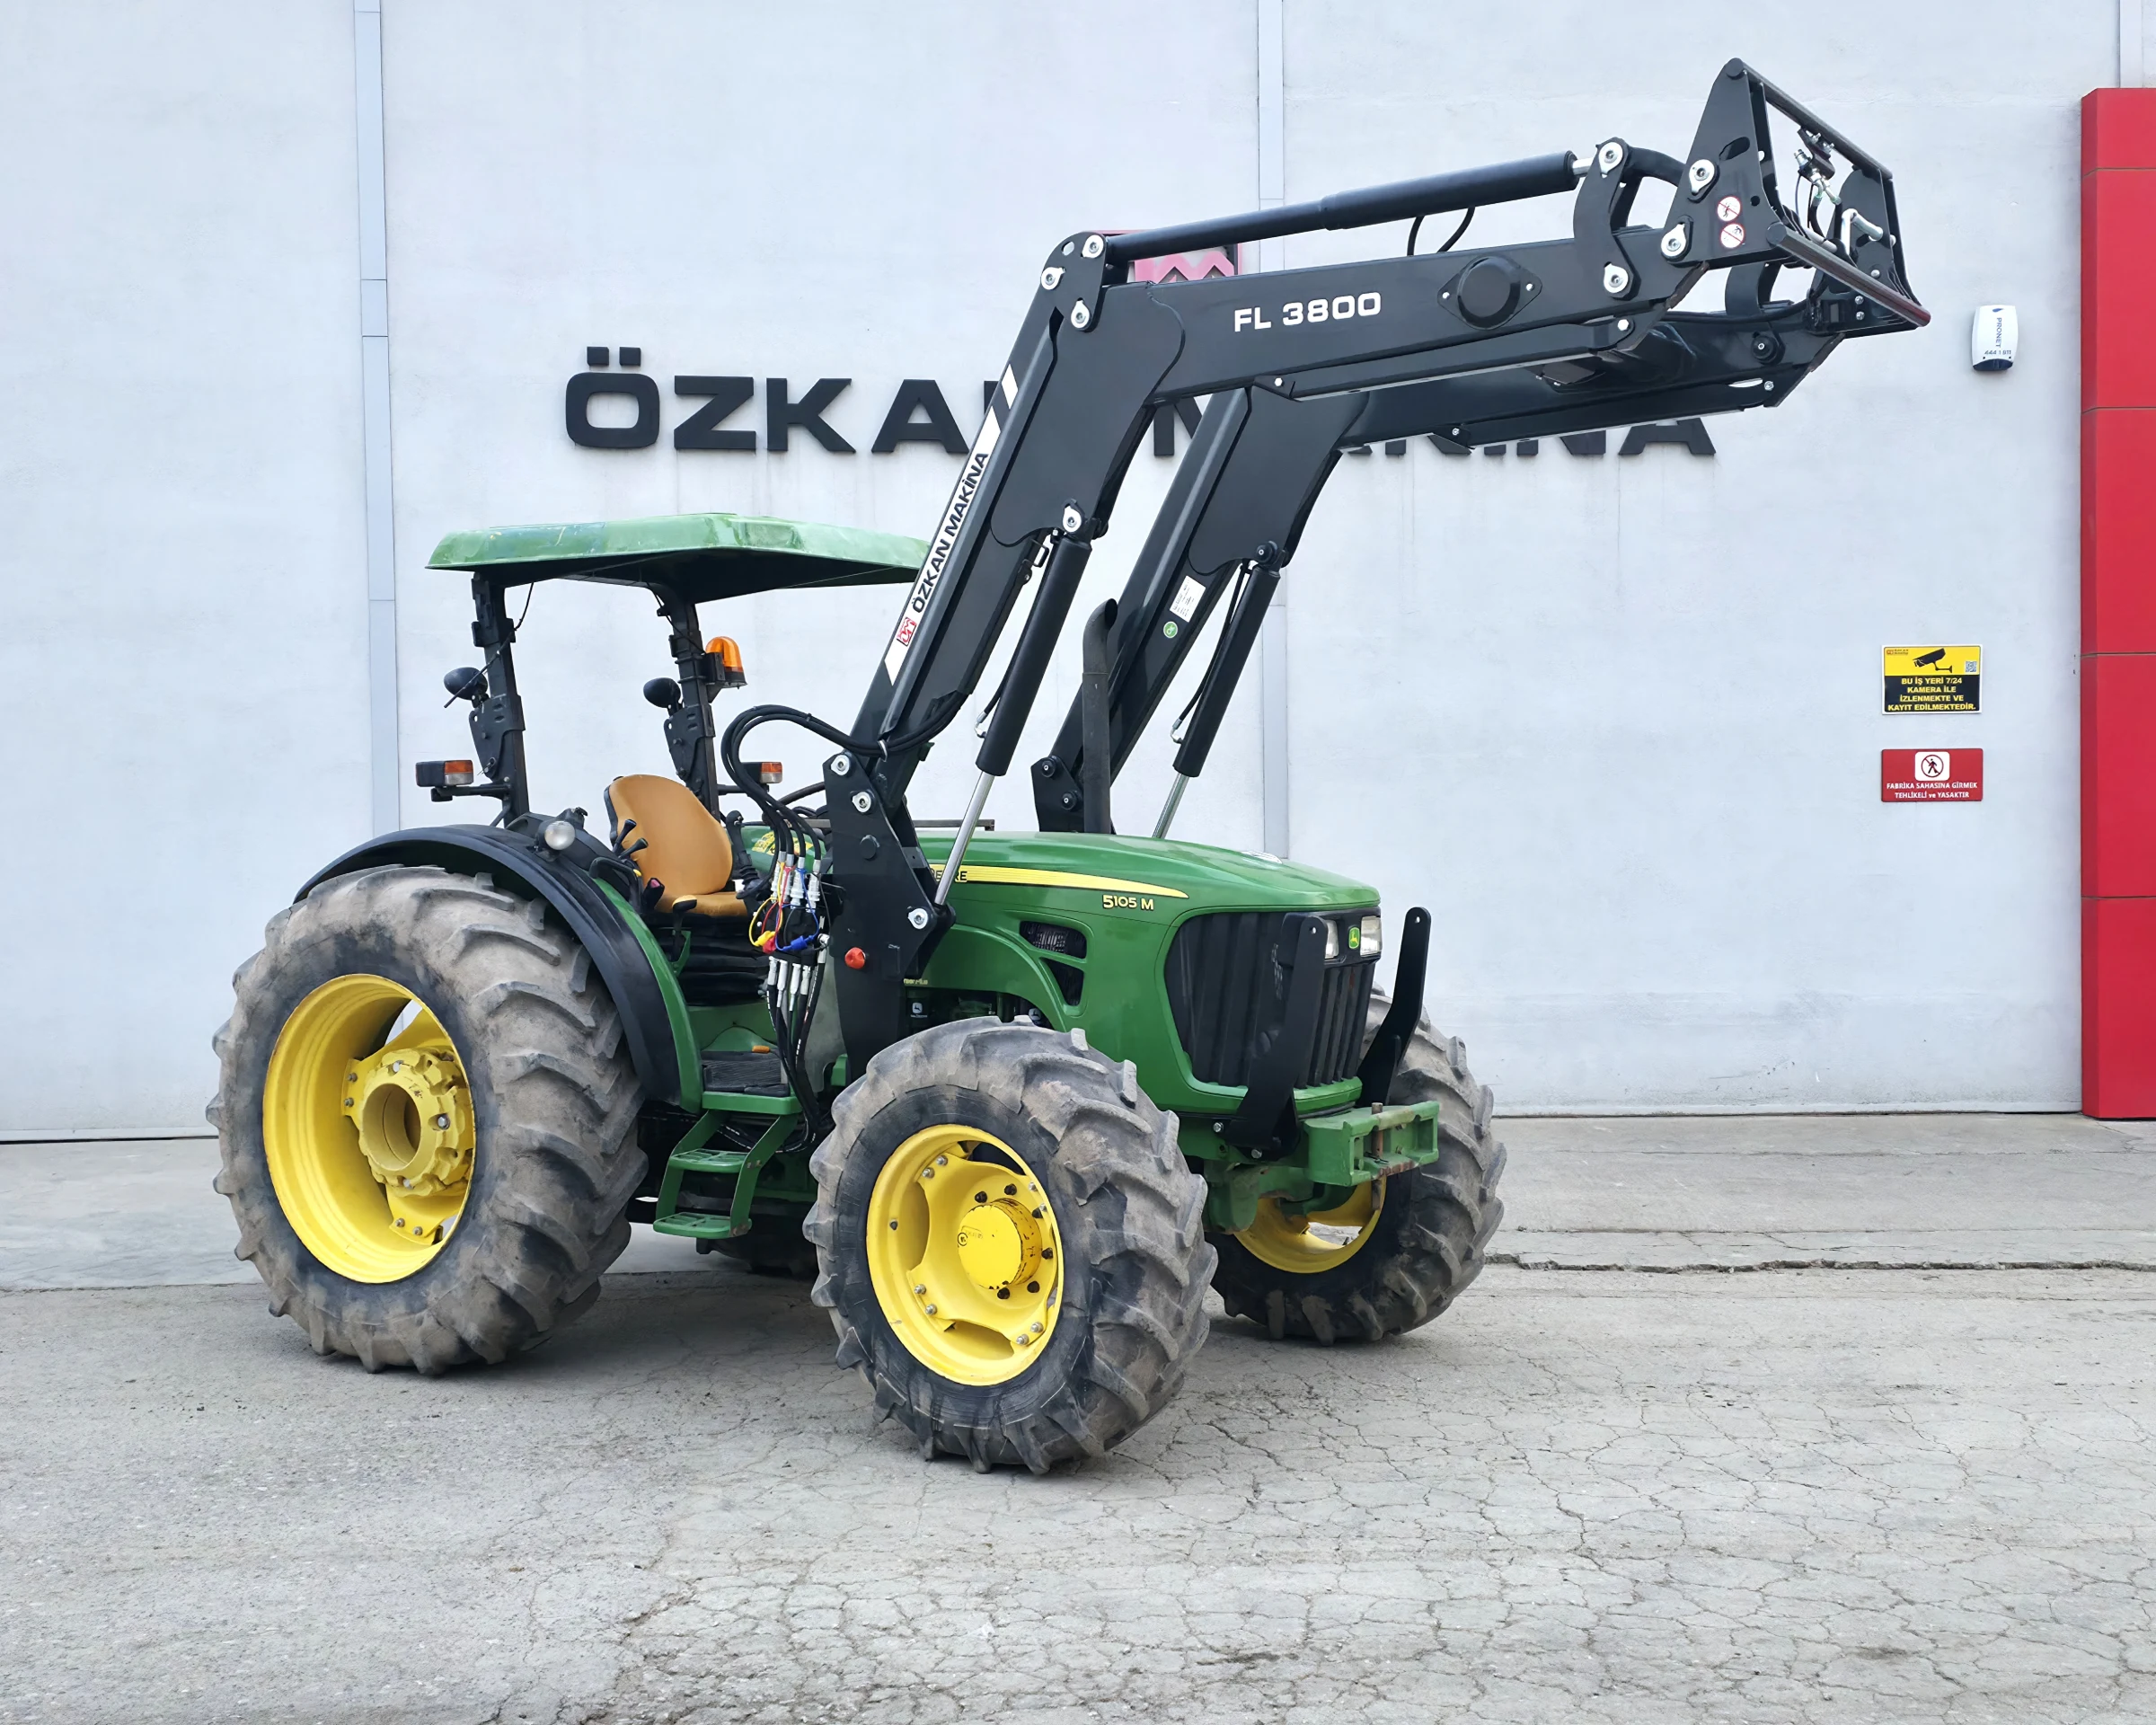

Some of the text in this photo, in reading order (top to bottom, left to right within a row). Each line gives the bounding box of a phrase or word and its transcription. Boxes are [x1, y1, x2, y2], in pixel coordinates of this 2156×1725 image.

[1234, 292, 1382, 332] FL 3800
[566, 346, 999, 454] ÖZKA
[911, 453, 989, 614] ÖZKAN MAKİNA
[1914, 677, 1923, 686] İŞ
[1925, 677, 1944, 685] YERİ
[1895, 791, 1927, 799] TEHLİKELİ
[1102, 894, 1154, 911] 5105 M
